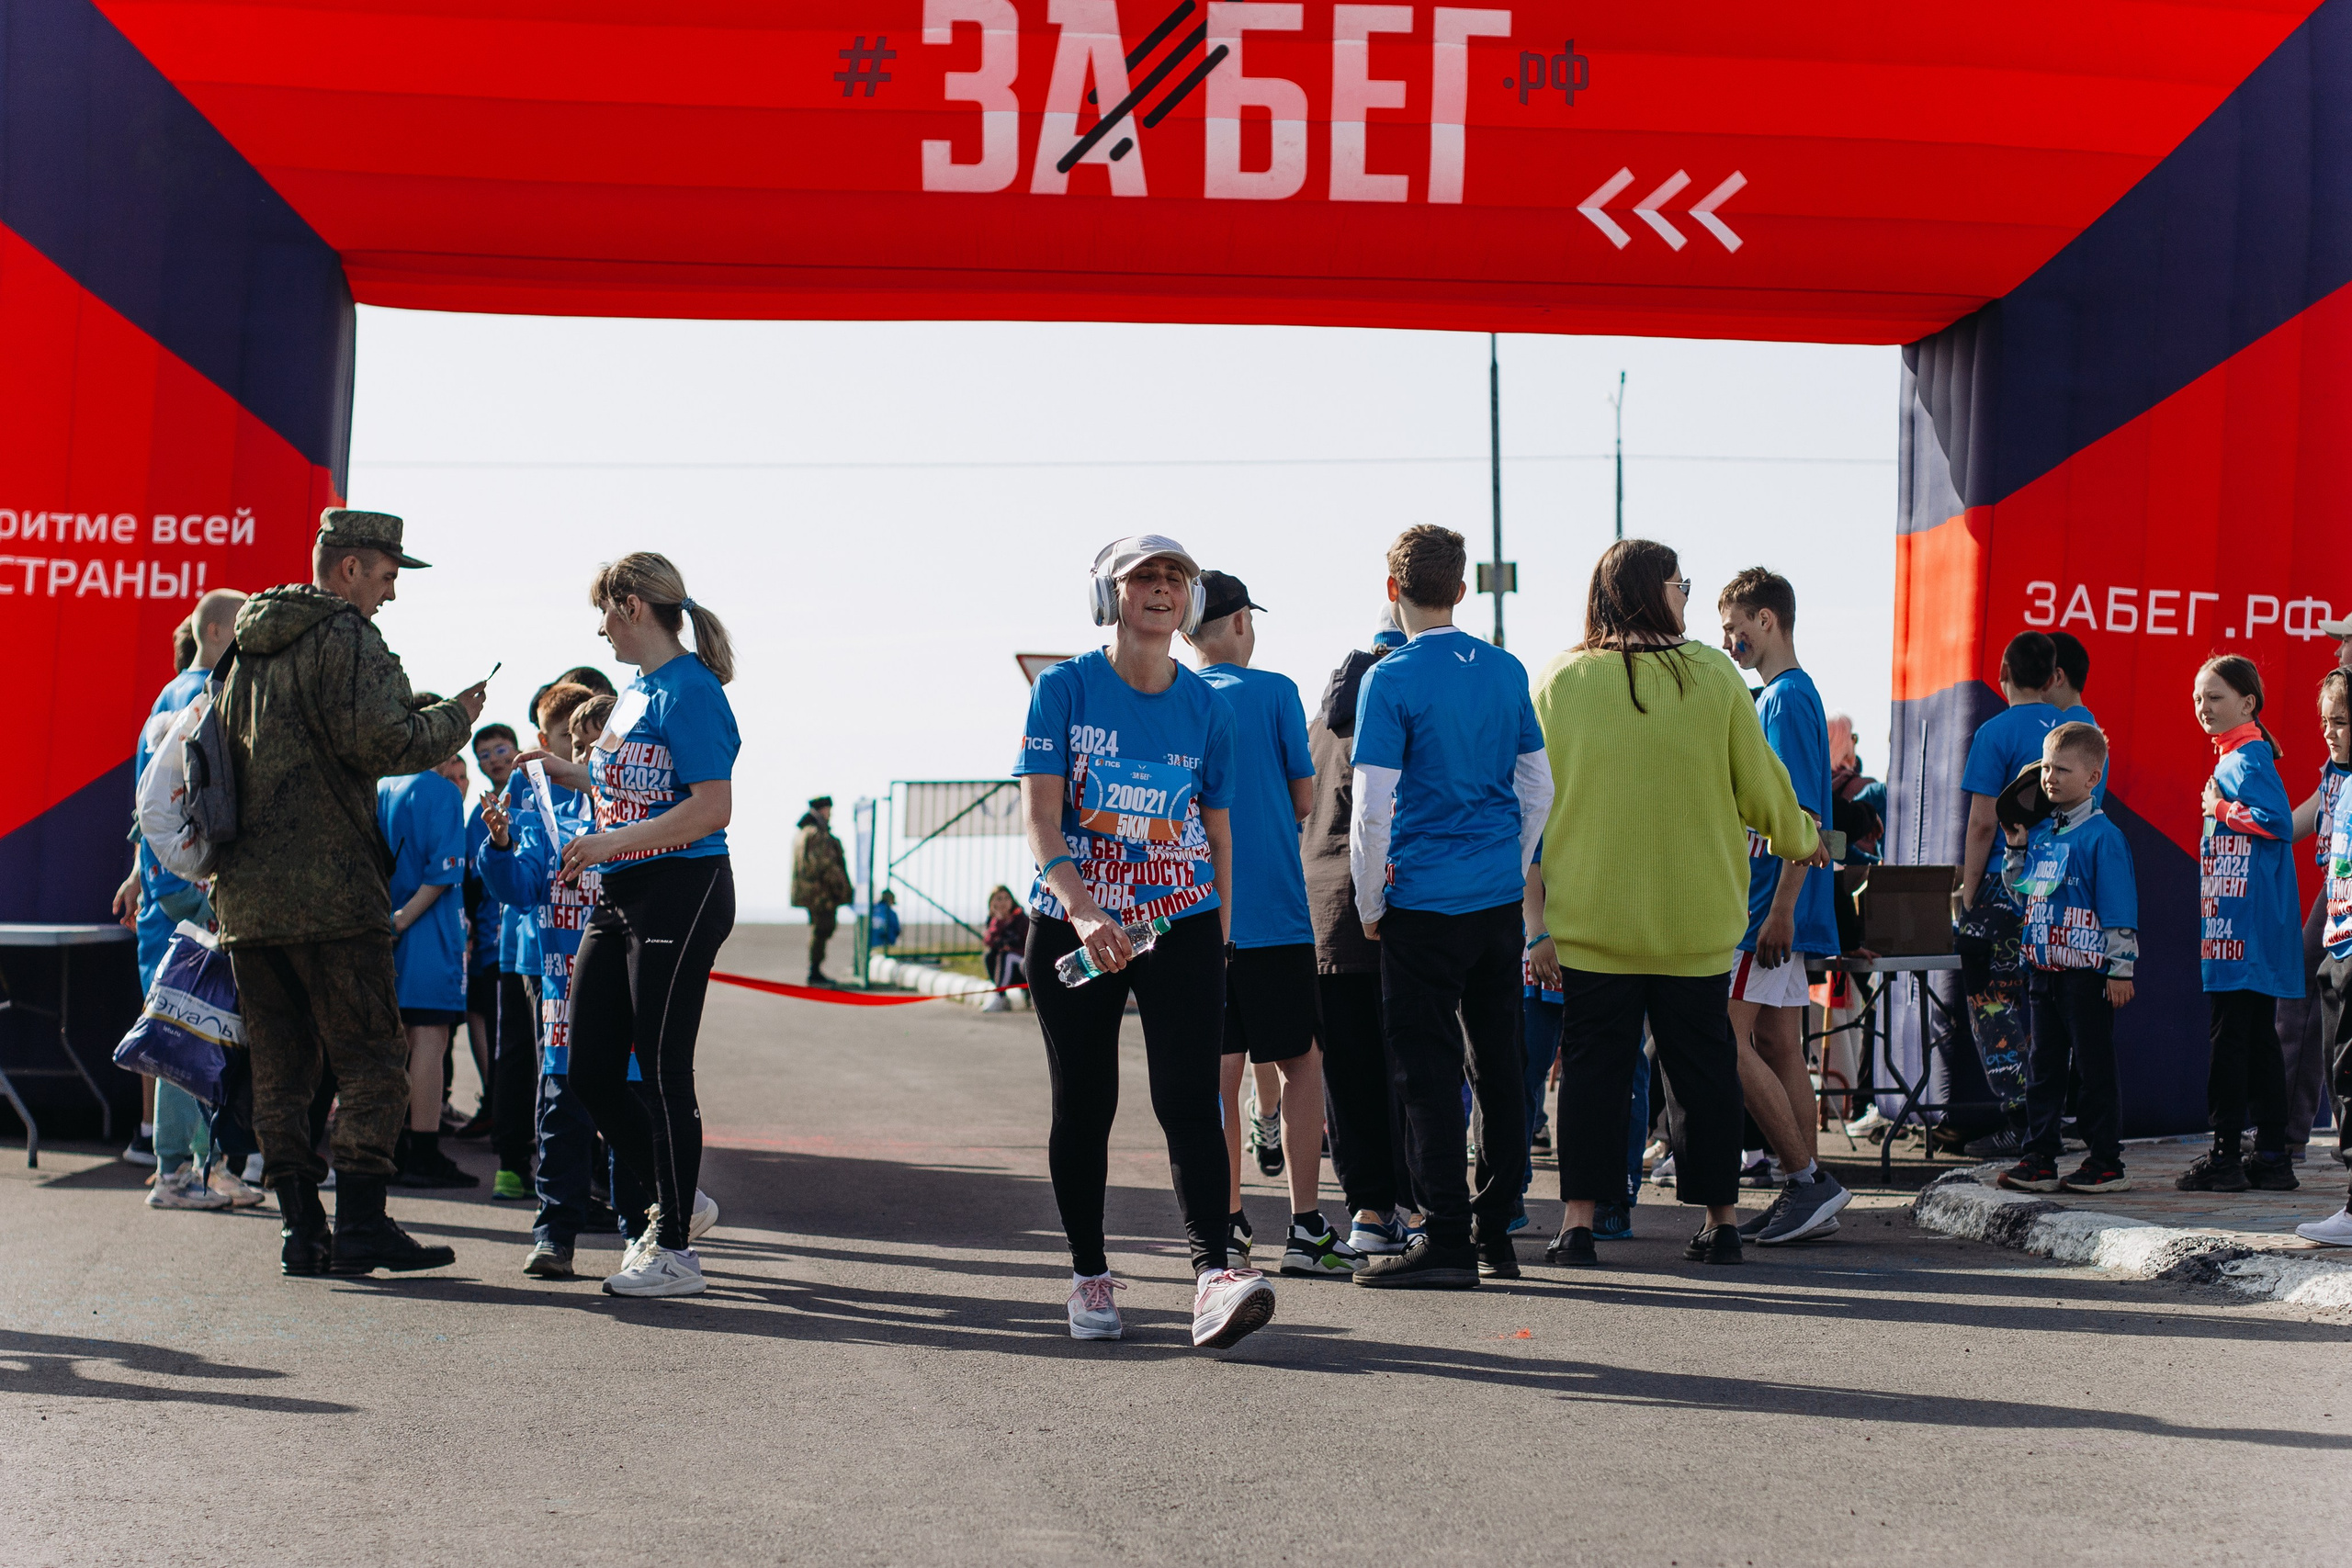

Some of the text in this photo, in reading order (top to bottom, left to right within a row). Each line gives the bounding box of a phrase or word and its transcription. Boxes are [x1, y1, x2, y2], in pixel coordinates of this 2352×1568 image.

[152, 507, 256, 546] всей
[1024, 736, 1055, 751] ПСБ
[1070, 724, 1119, 758] 2024
[1104, 760, 1121, 769] ПСБ
[1105, 783, 1168, 815] 20021
[1065, 835, 1127, 861] ЗАБЕГ
[2209, 835, 2252, 856] #ЦЕЛЬ
[1080, 859, 1195, 887] #ГОРДОСТЬ
[2205, 917, 2233, 939] 2024
